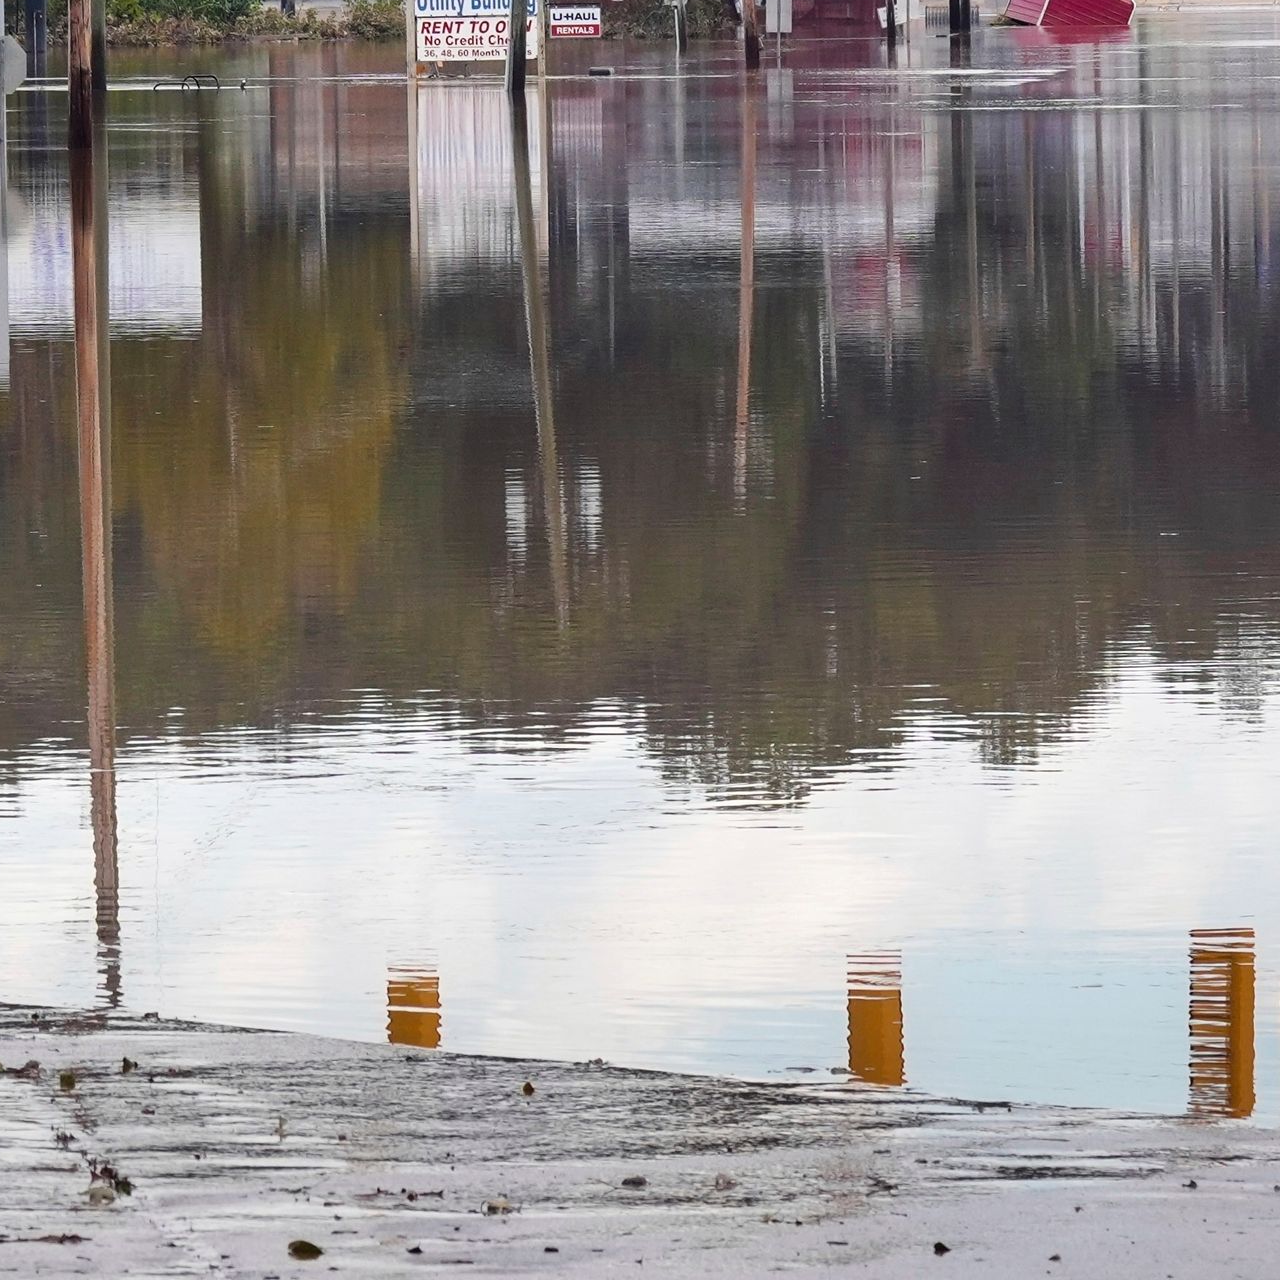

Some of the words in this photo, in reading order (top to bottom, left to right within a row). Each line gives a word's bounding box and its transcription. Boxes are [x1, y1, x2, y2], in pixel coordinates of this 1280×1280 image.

[552, 12, 598, 21] U-HAUL
[420, 21, 465, 35] RENT
[470, 21, 490, 34] TO
[556, 25, 595, 35] RENTALS
[424, 35, 442, 46] No
[446, 35, 484, 46] Credit
[424, 49, 439, 59] 36,
[441, 49, 455, 59] 48,
[457, 49, 469, 58] 60
[471, 48, 501, 58] Month
